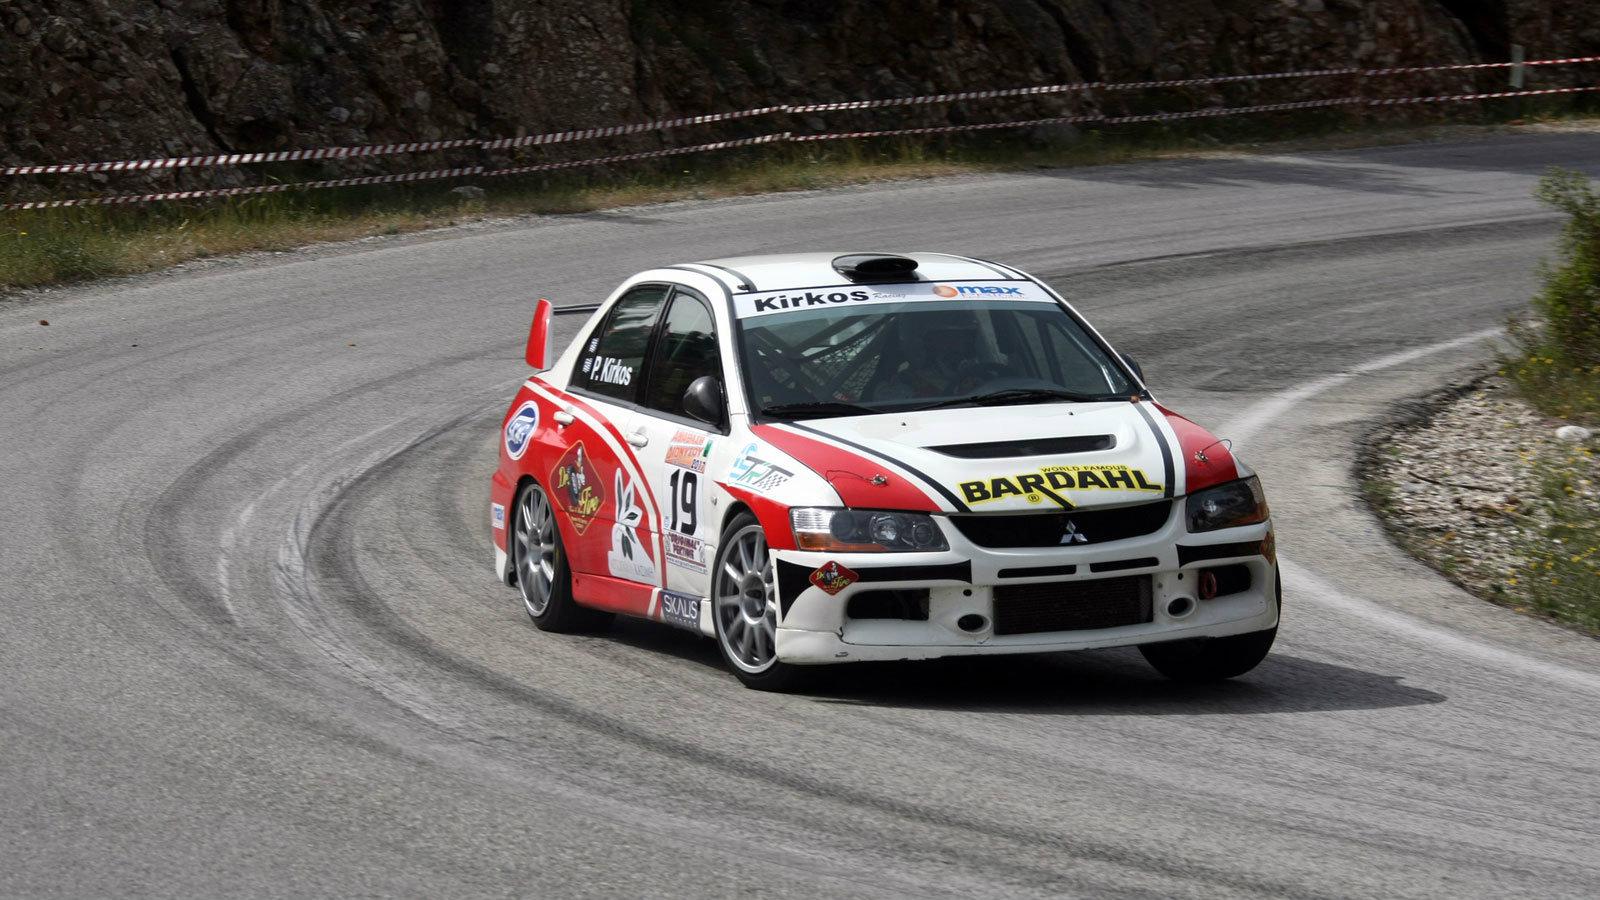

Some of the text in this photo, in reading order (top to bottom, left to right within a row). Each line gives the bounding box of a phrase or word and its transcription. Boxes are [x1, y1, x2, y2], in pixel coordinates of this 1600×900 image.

[754, 290, 870, 312] Kirkos
[590, 355, 633, 386] P. Kirkos
[669, 468, 698, 536] 19
[960, 470, 1162, 511] BARDAHL
